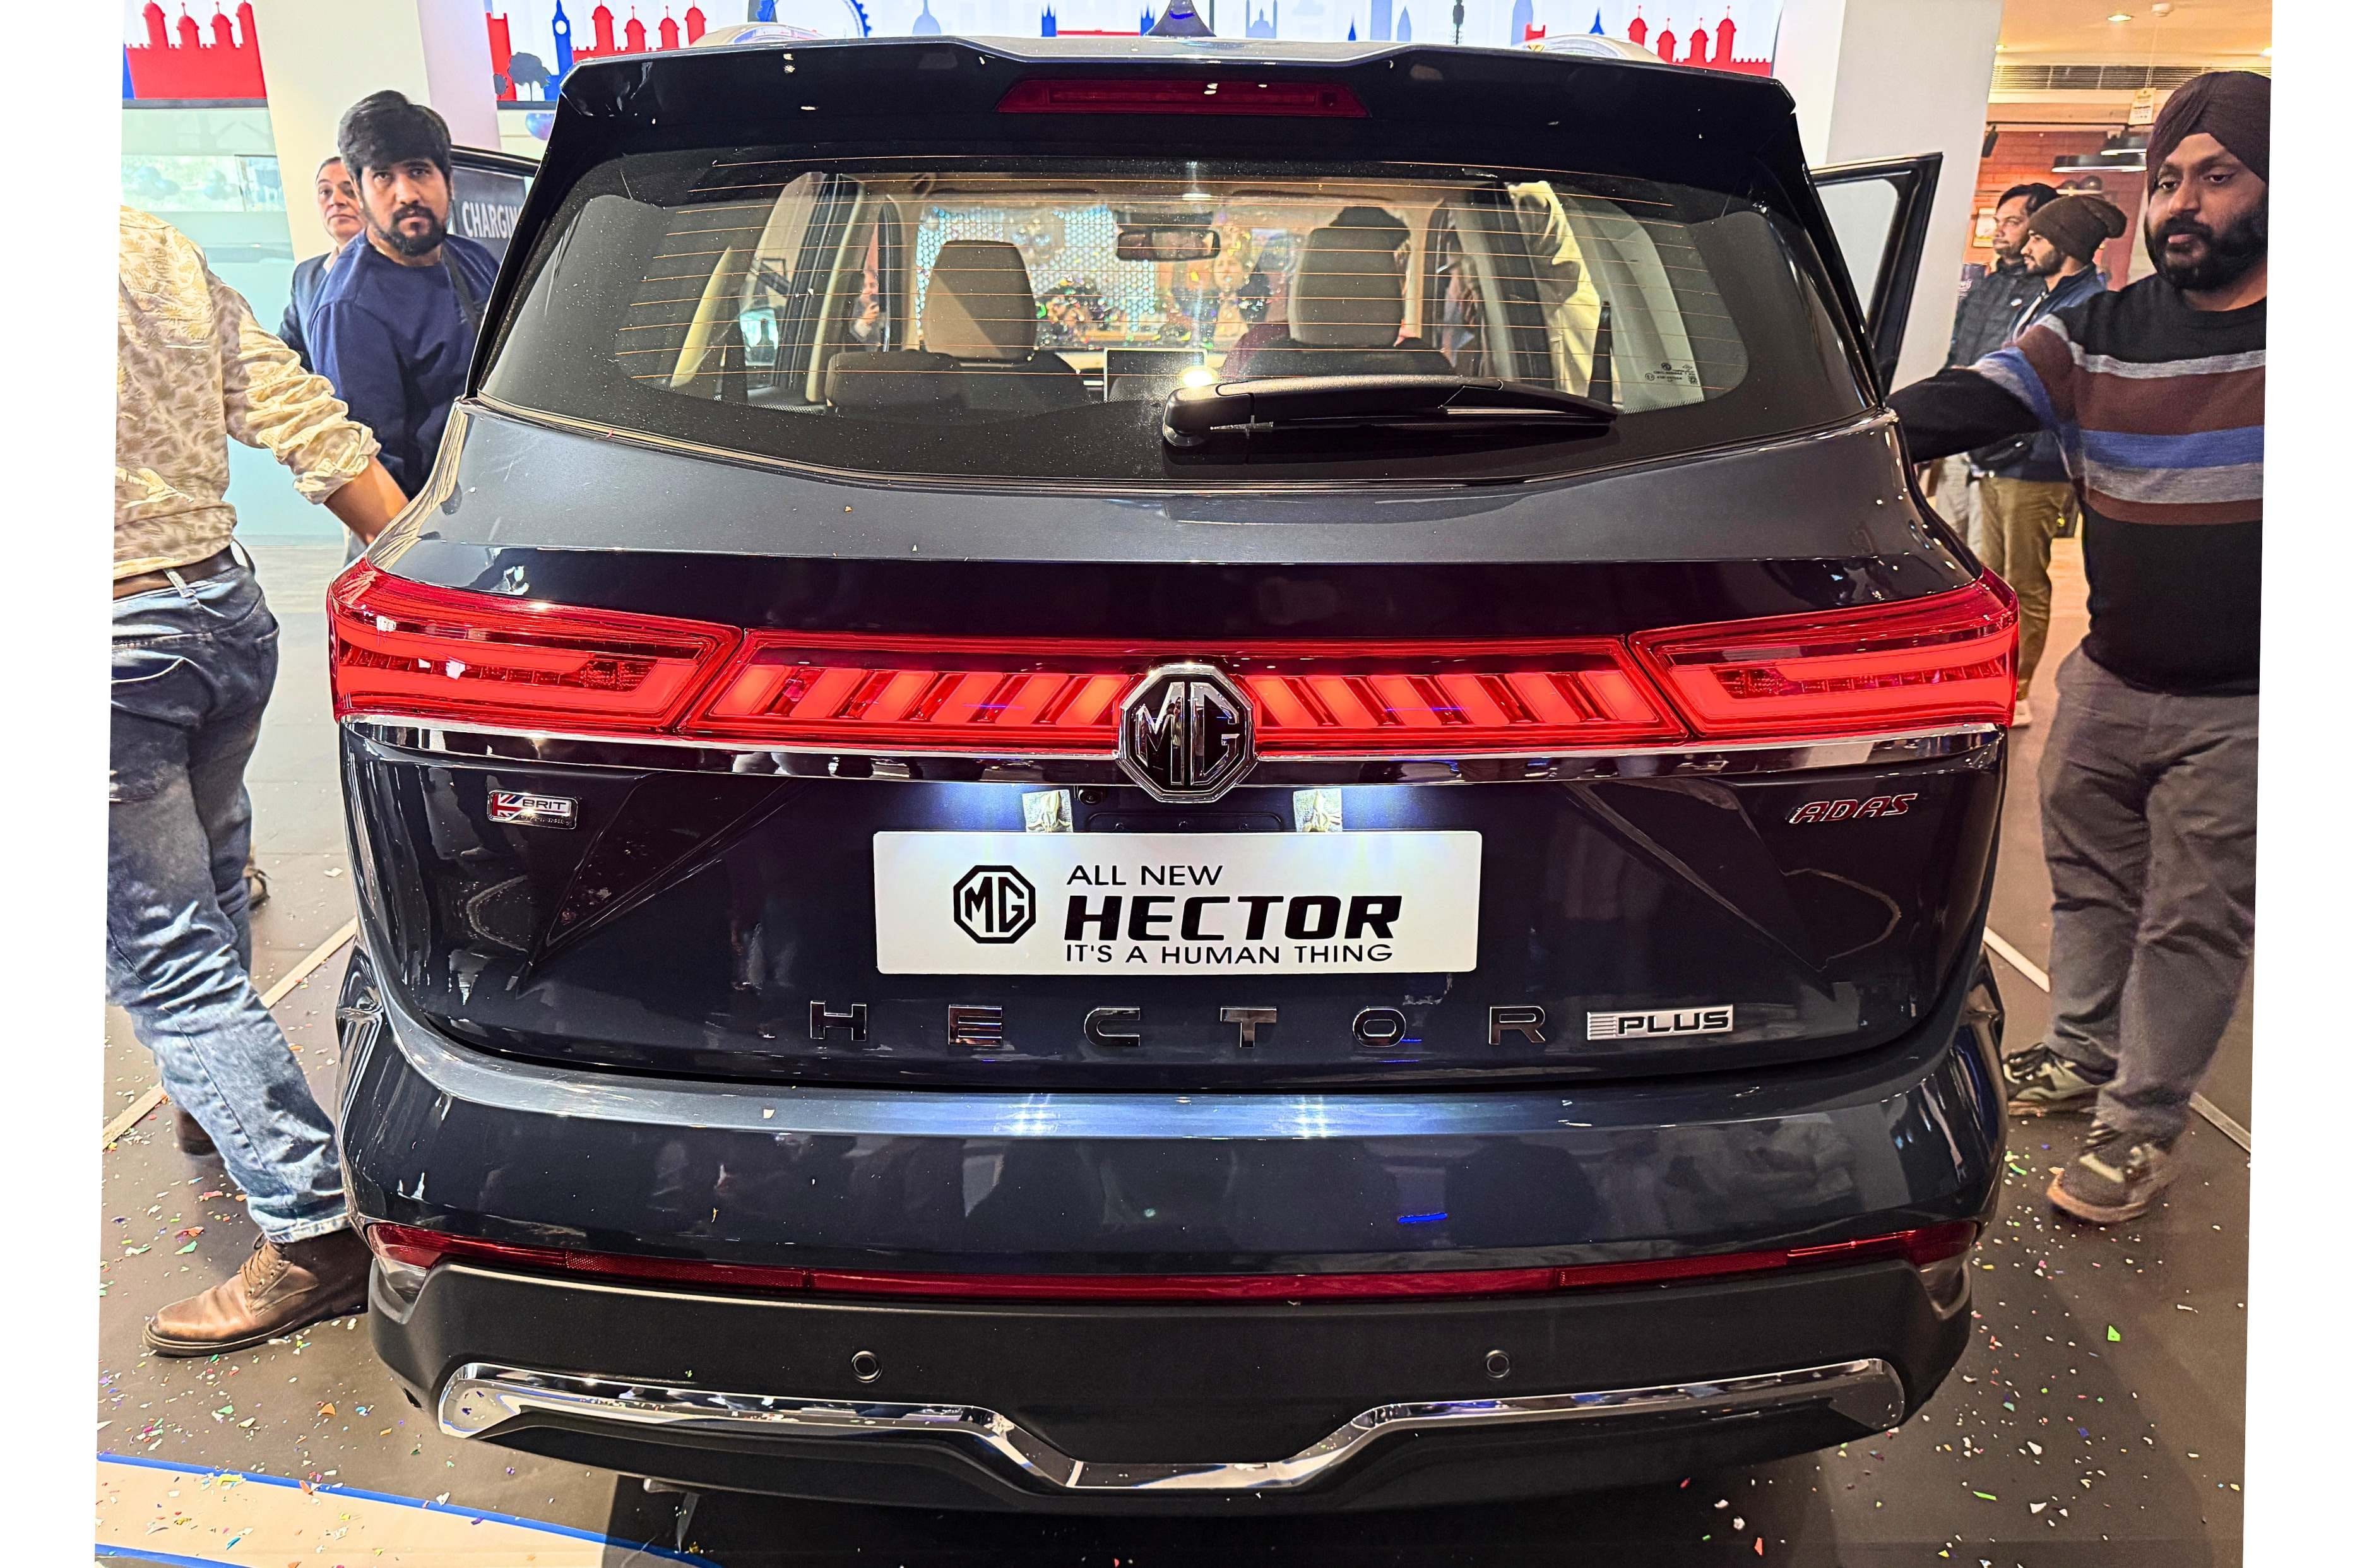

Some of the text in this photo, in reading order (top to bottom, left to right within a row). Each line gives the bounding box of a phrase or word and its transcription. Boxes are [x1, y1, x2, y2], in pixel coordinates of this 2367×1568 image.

[461, 201, 523, 239] CHARGIN
[1135, 681, 1240, 786] MG
[522, 799, 567, 811] BRIT
[1789, 793, 1918, 824] ADAS
[1066, 865, 1223, 886] ALL NEW
[964, 876, 1026, 934] MG
[1064, 895, 1403, 941] HECTOR
[1067, 944, 1392, 965] IT'S A HUMAN THING
[810, 1000, 1729, 1048] HECTOR PLUS
